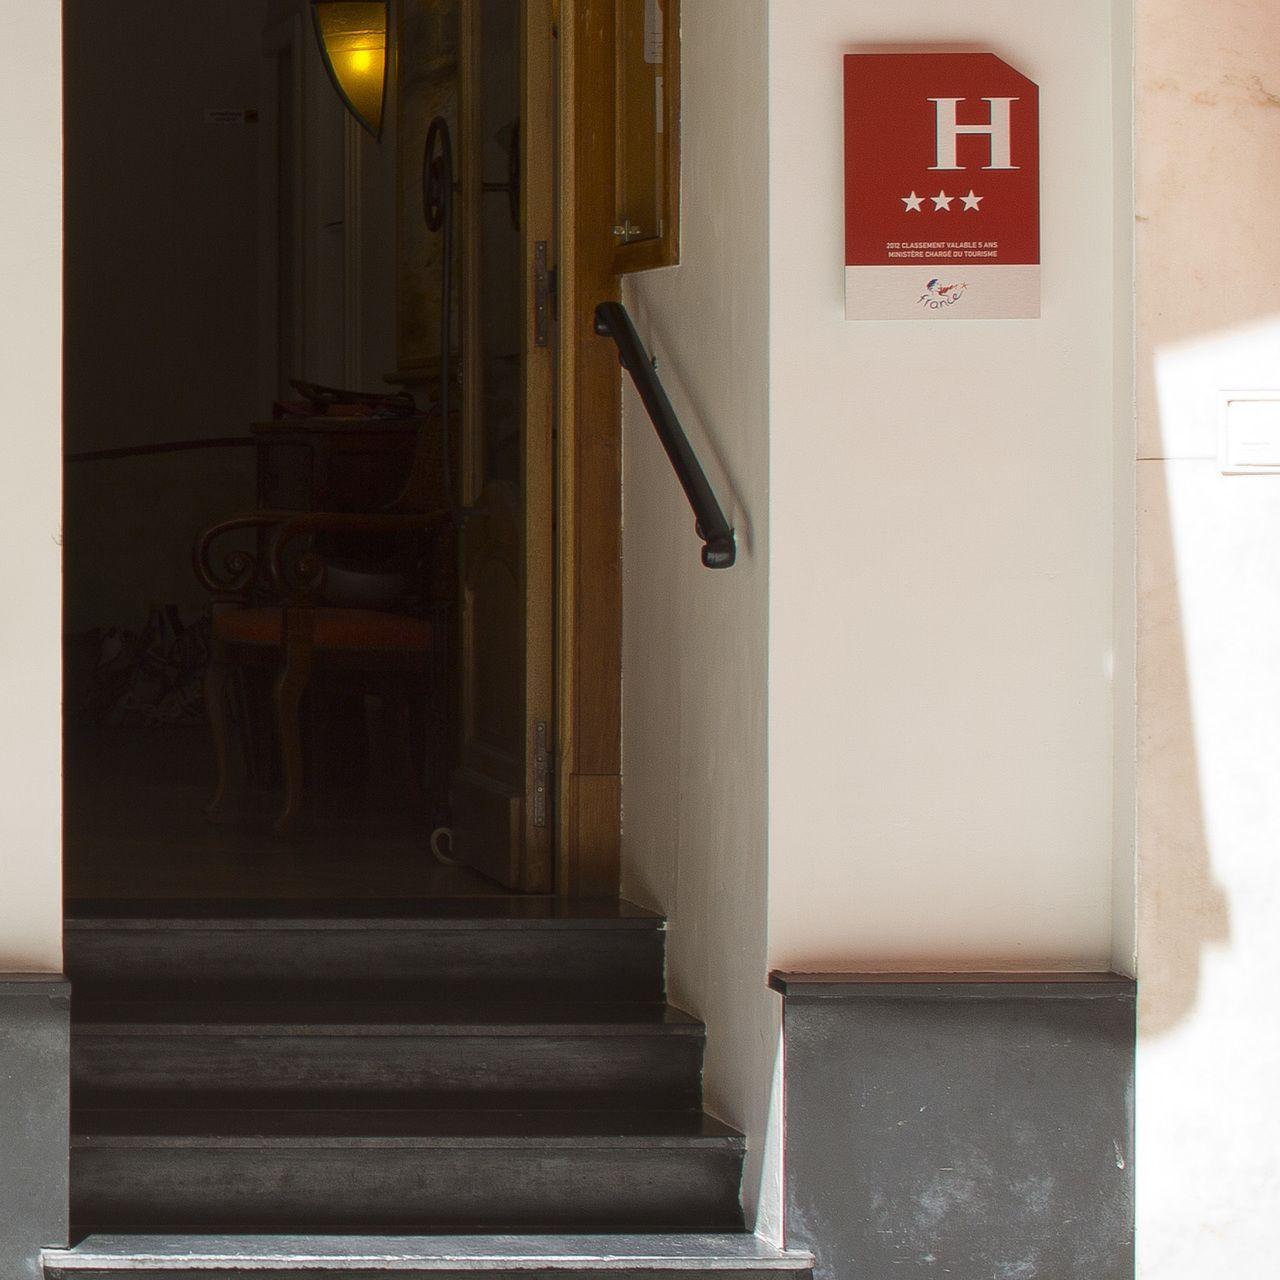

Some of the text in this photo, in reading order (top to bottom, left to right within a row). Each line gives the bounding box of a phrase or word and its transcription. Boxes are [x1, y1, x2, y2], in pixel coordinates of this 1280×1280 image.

[926, 97, 1021, 170] H
[901, 241, 945, 249] CLASSEMENT
[946, 241, 977, 249] VALABLE
[978, 241, 982, 249] 5
[983, 241, 998, 249] ANS
[953, 250, 963, 258] DU
[964, 250, 998, 258] TOURISME
